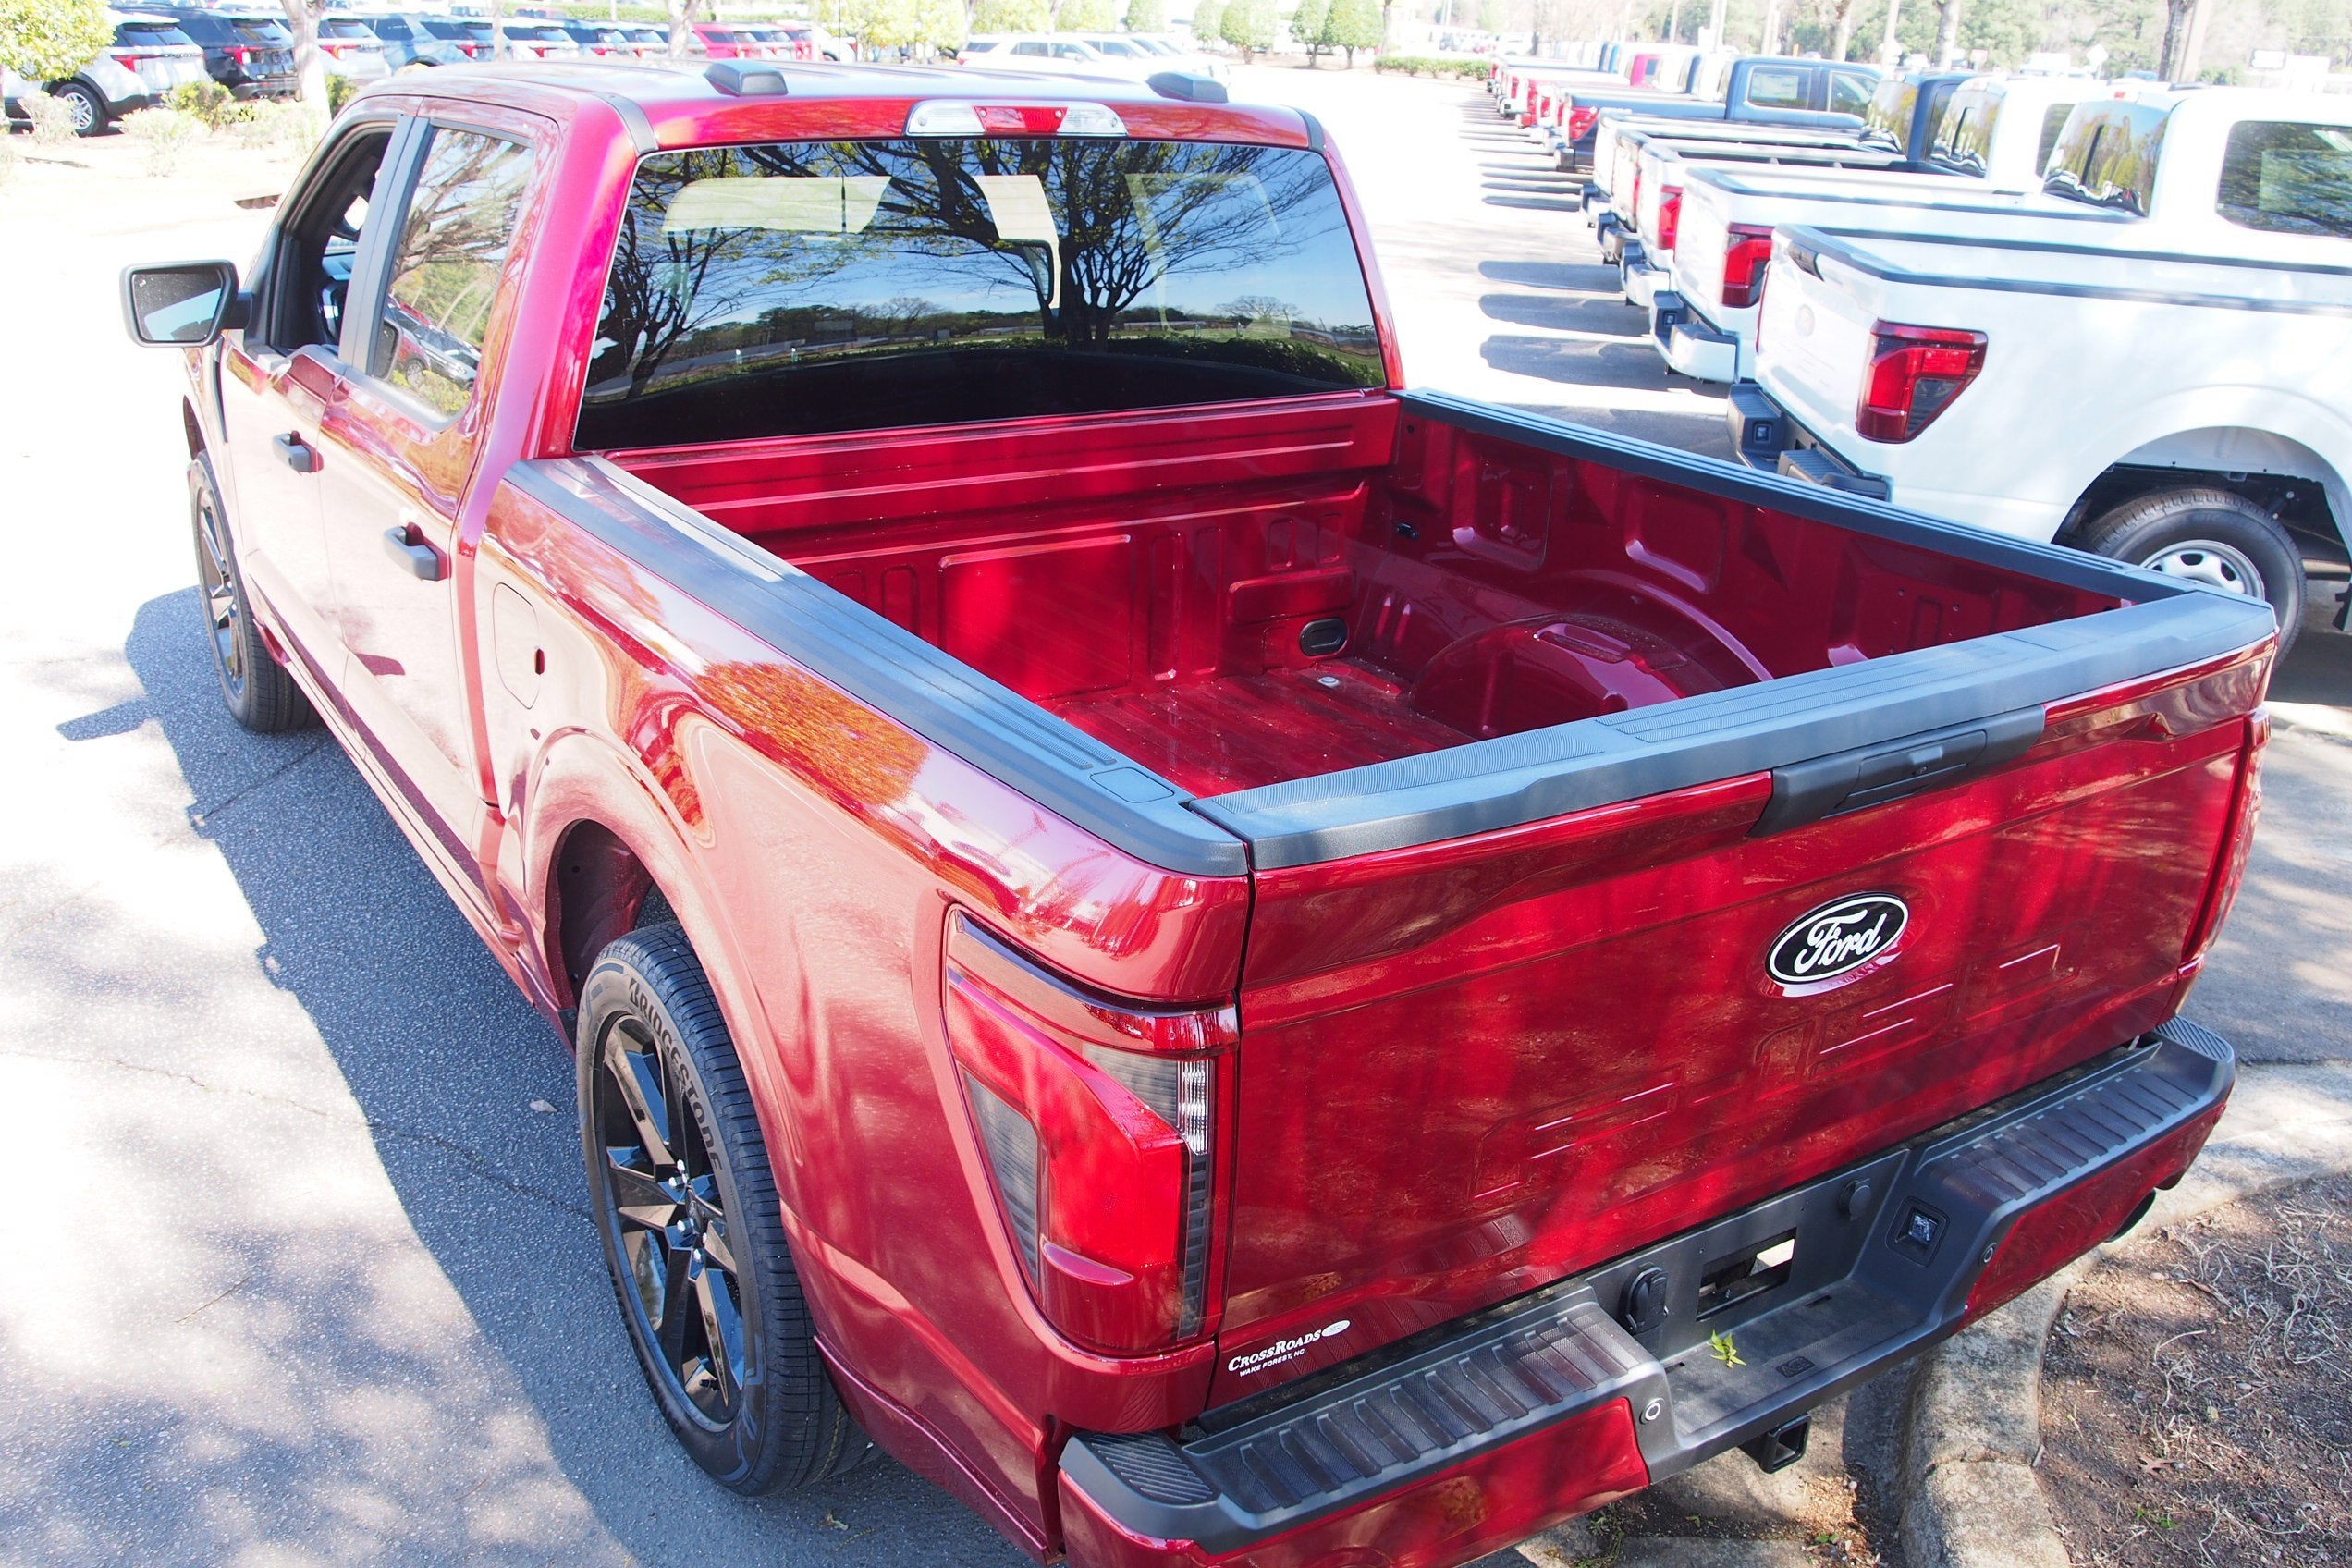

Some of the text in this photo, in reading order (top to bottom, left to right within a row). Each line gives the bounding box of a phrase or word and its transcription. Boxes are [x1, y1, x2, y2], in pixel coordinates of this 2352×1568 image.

[1794, 909, 1888, 974] Ford
[628, 976, 723, 1170] BRIDGESTONE
[1240, 1349, 1305, 1377] WAKE FOREST, NC
